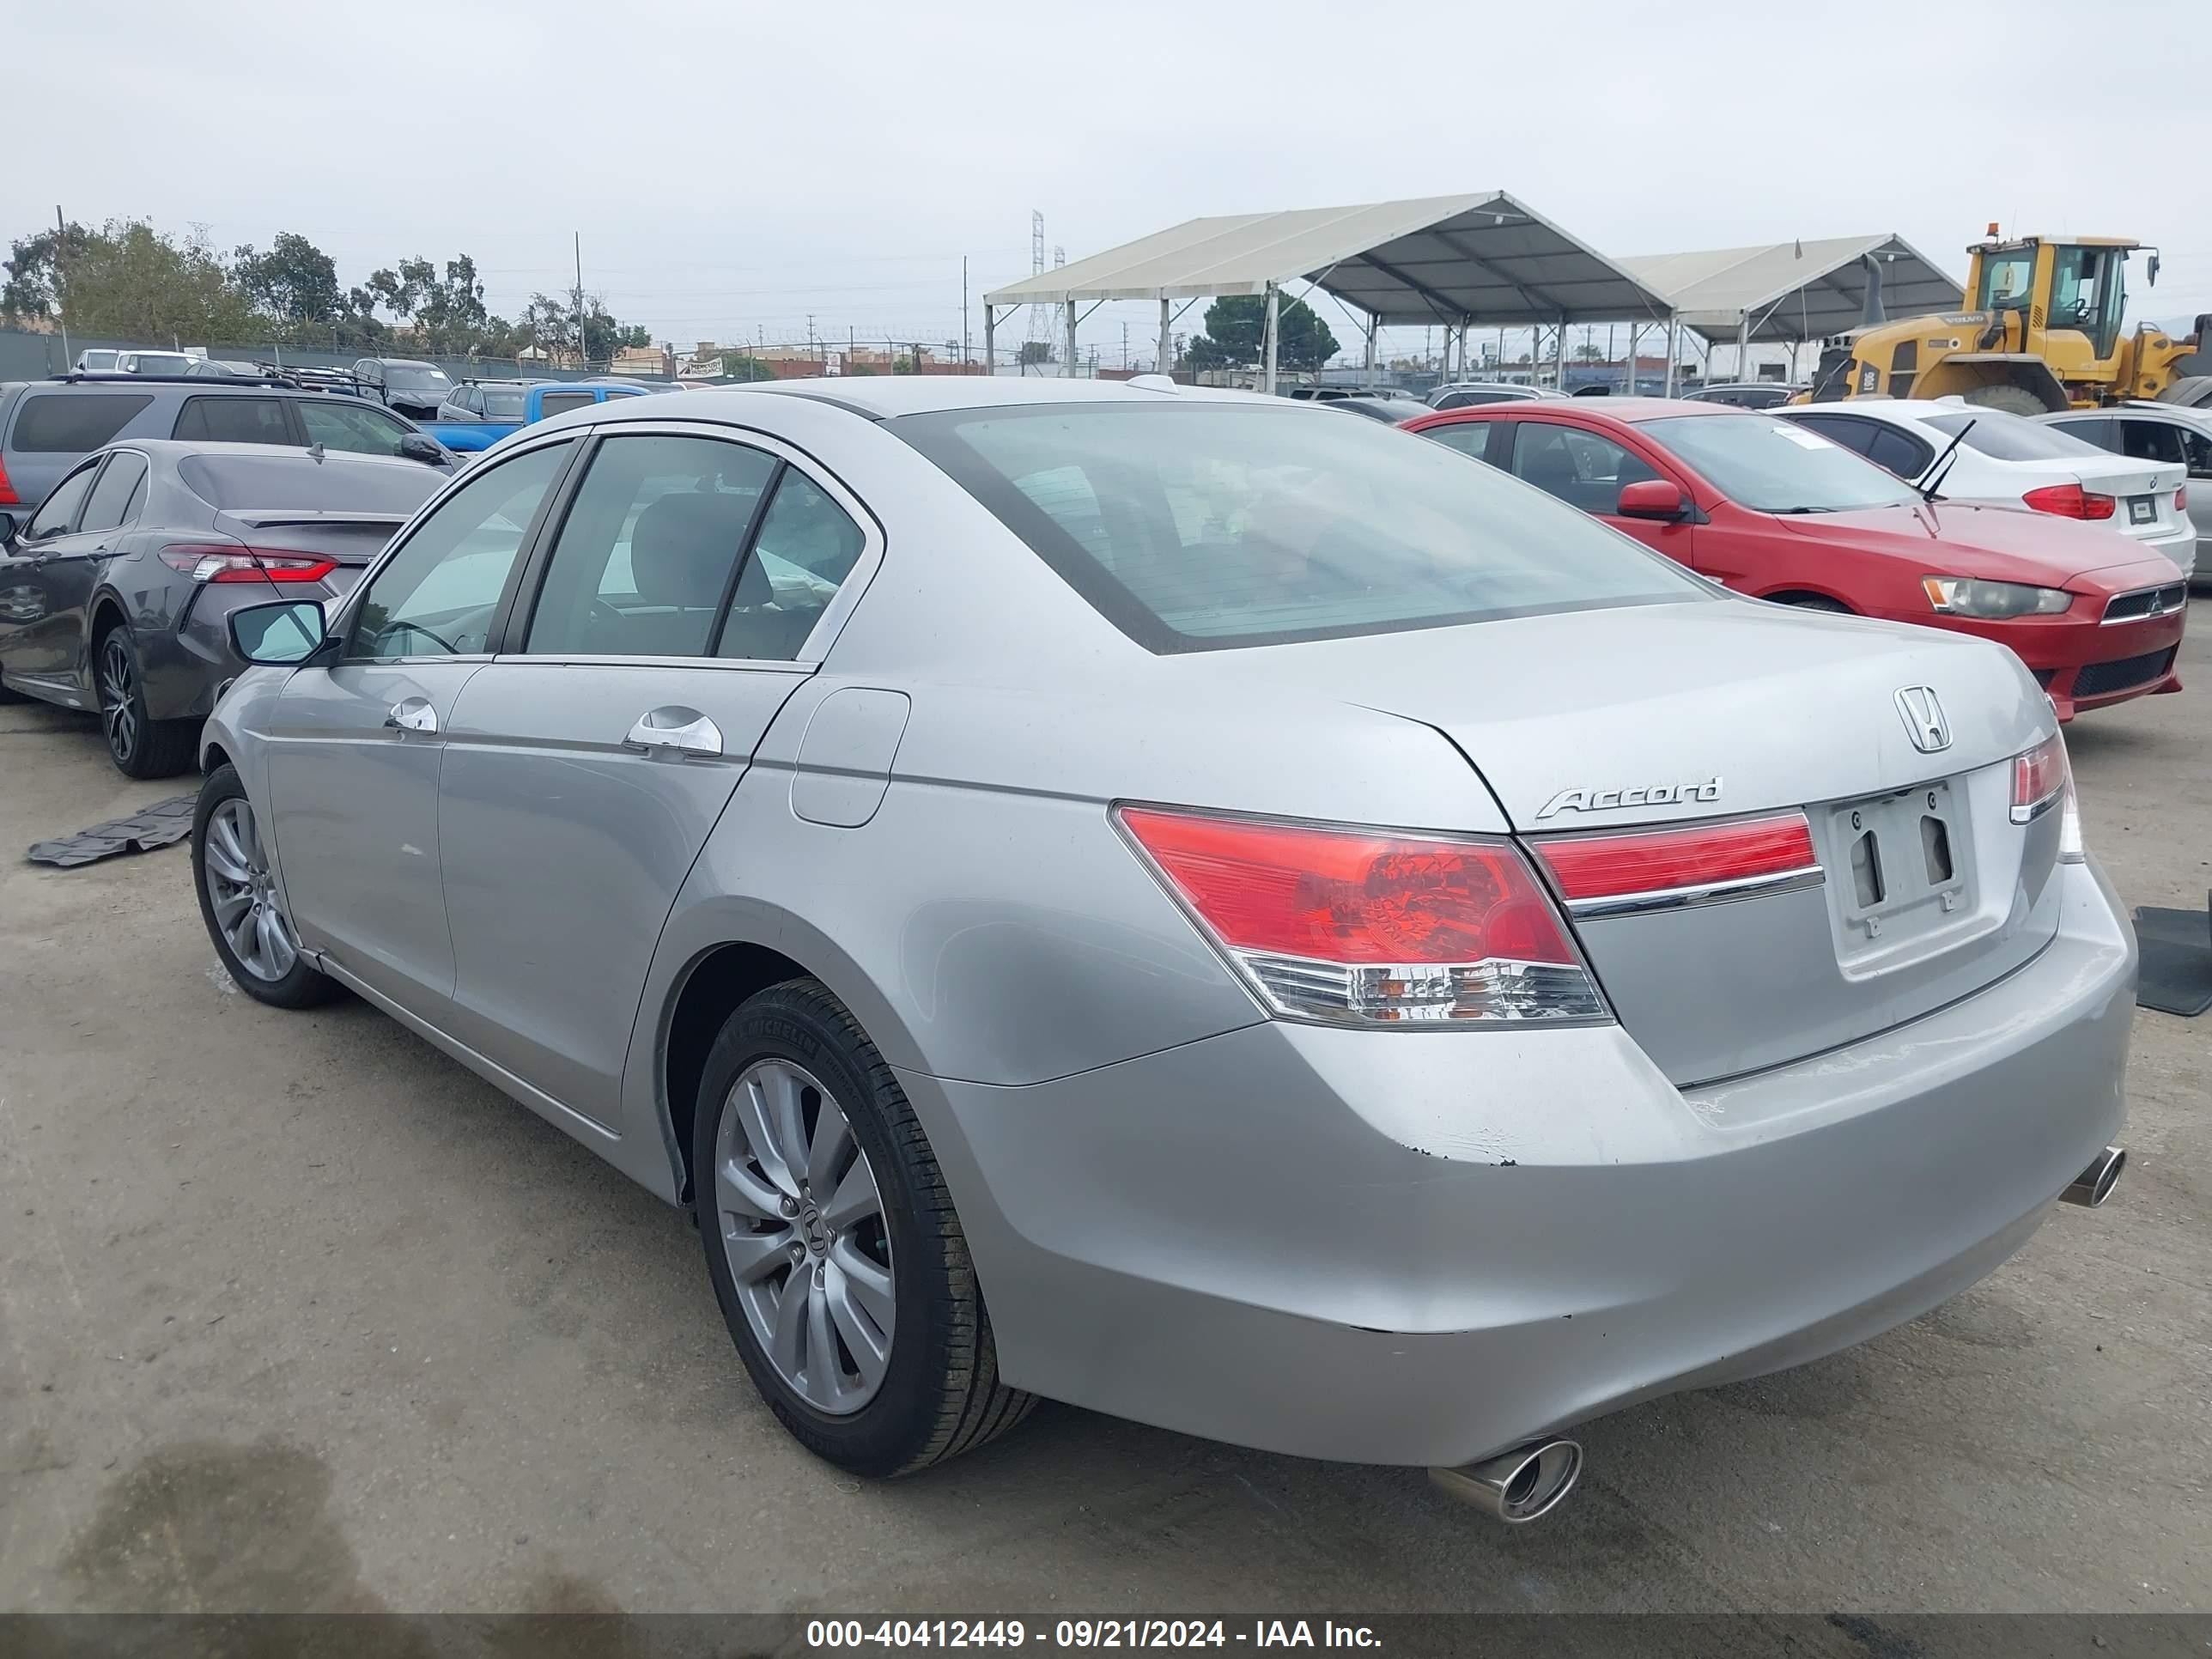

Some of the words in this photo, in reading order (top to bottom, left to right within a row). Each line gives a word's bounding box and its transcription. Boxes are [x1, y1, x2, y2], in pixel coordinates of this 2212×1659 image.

[1945, 315, 1984, 324] VOLVO
[1535, 776, 1724, 818] Accord
[748, 1019, 819, 1056] MICHELIN
